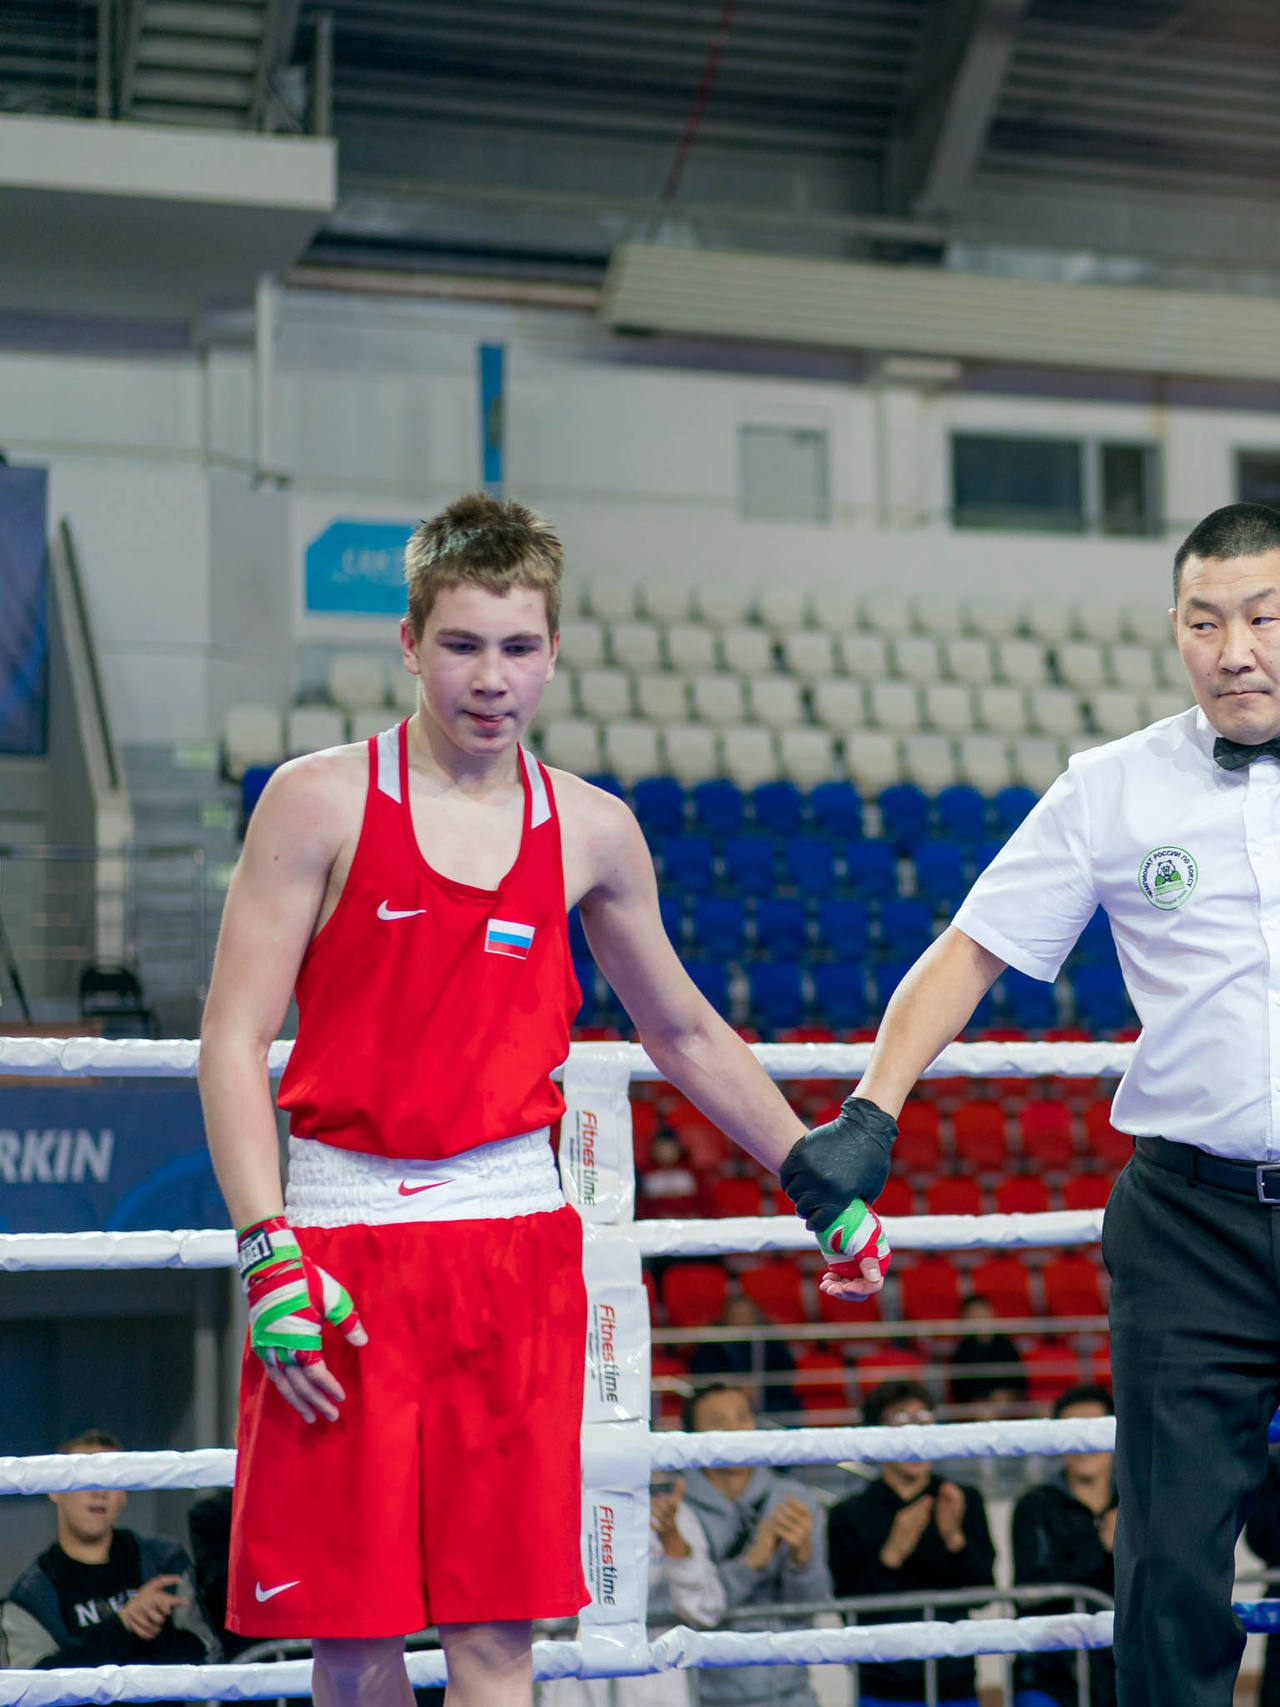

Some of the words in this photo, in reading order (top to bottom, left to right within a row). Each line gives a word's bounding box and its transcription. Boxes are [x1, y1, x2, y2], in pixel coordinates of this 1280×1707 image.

[1153, 850, 1182, 859] РОССИИ
[1181, 855, 1190, 865] ПО
[0, 1129, 114, 1183] RKIN
[582, 1110, 598, 1206] Fitnestime
[599, 1304, 619, 1404] Fitnestime
[599, 1504, 617, 1606] Fitnestime
